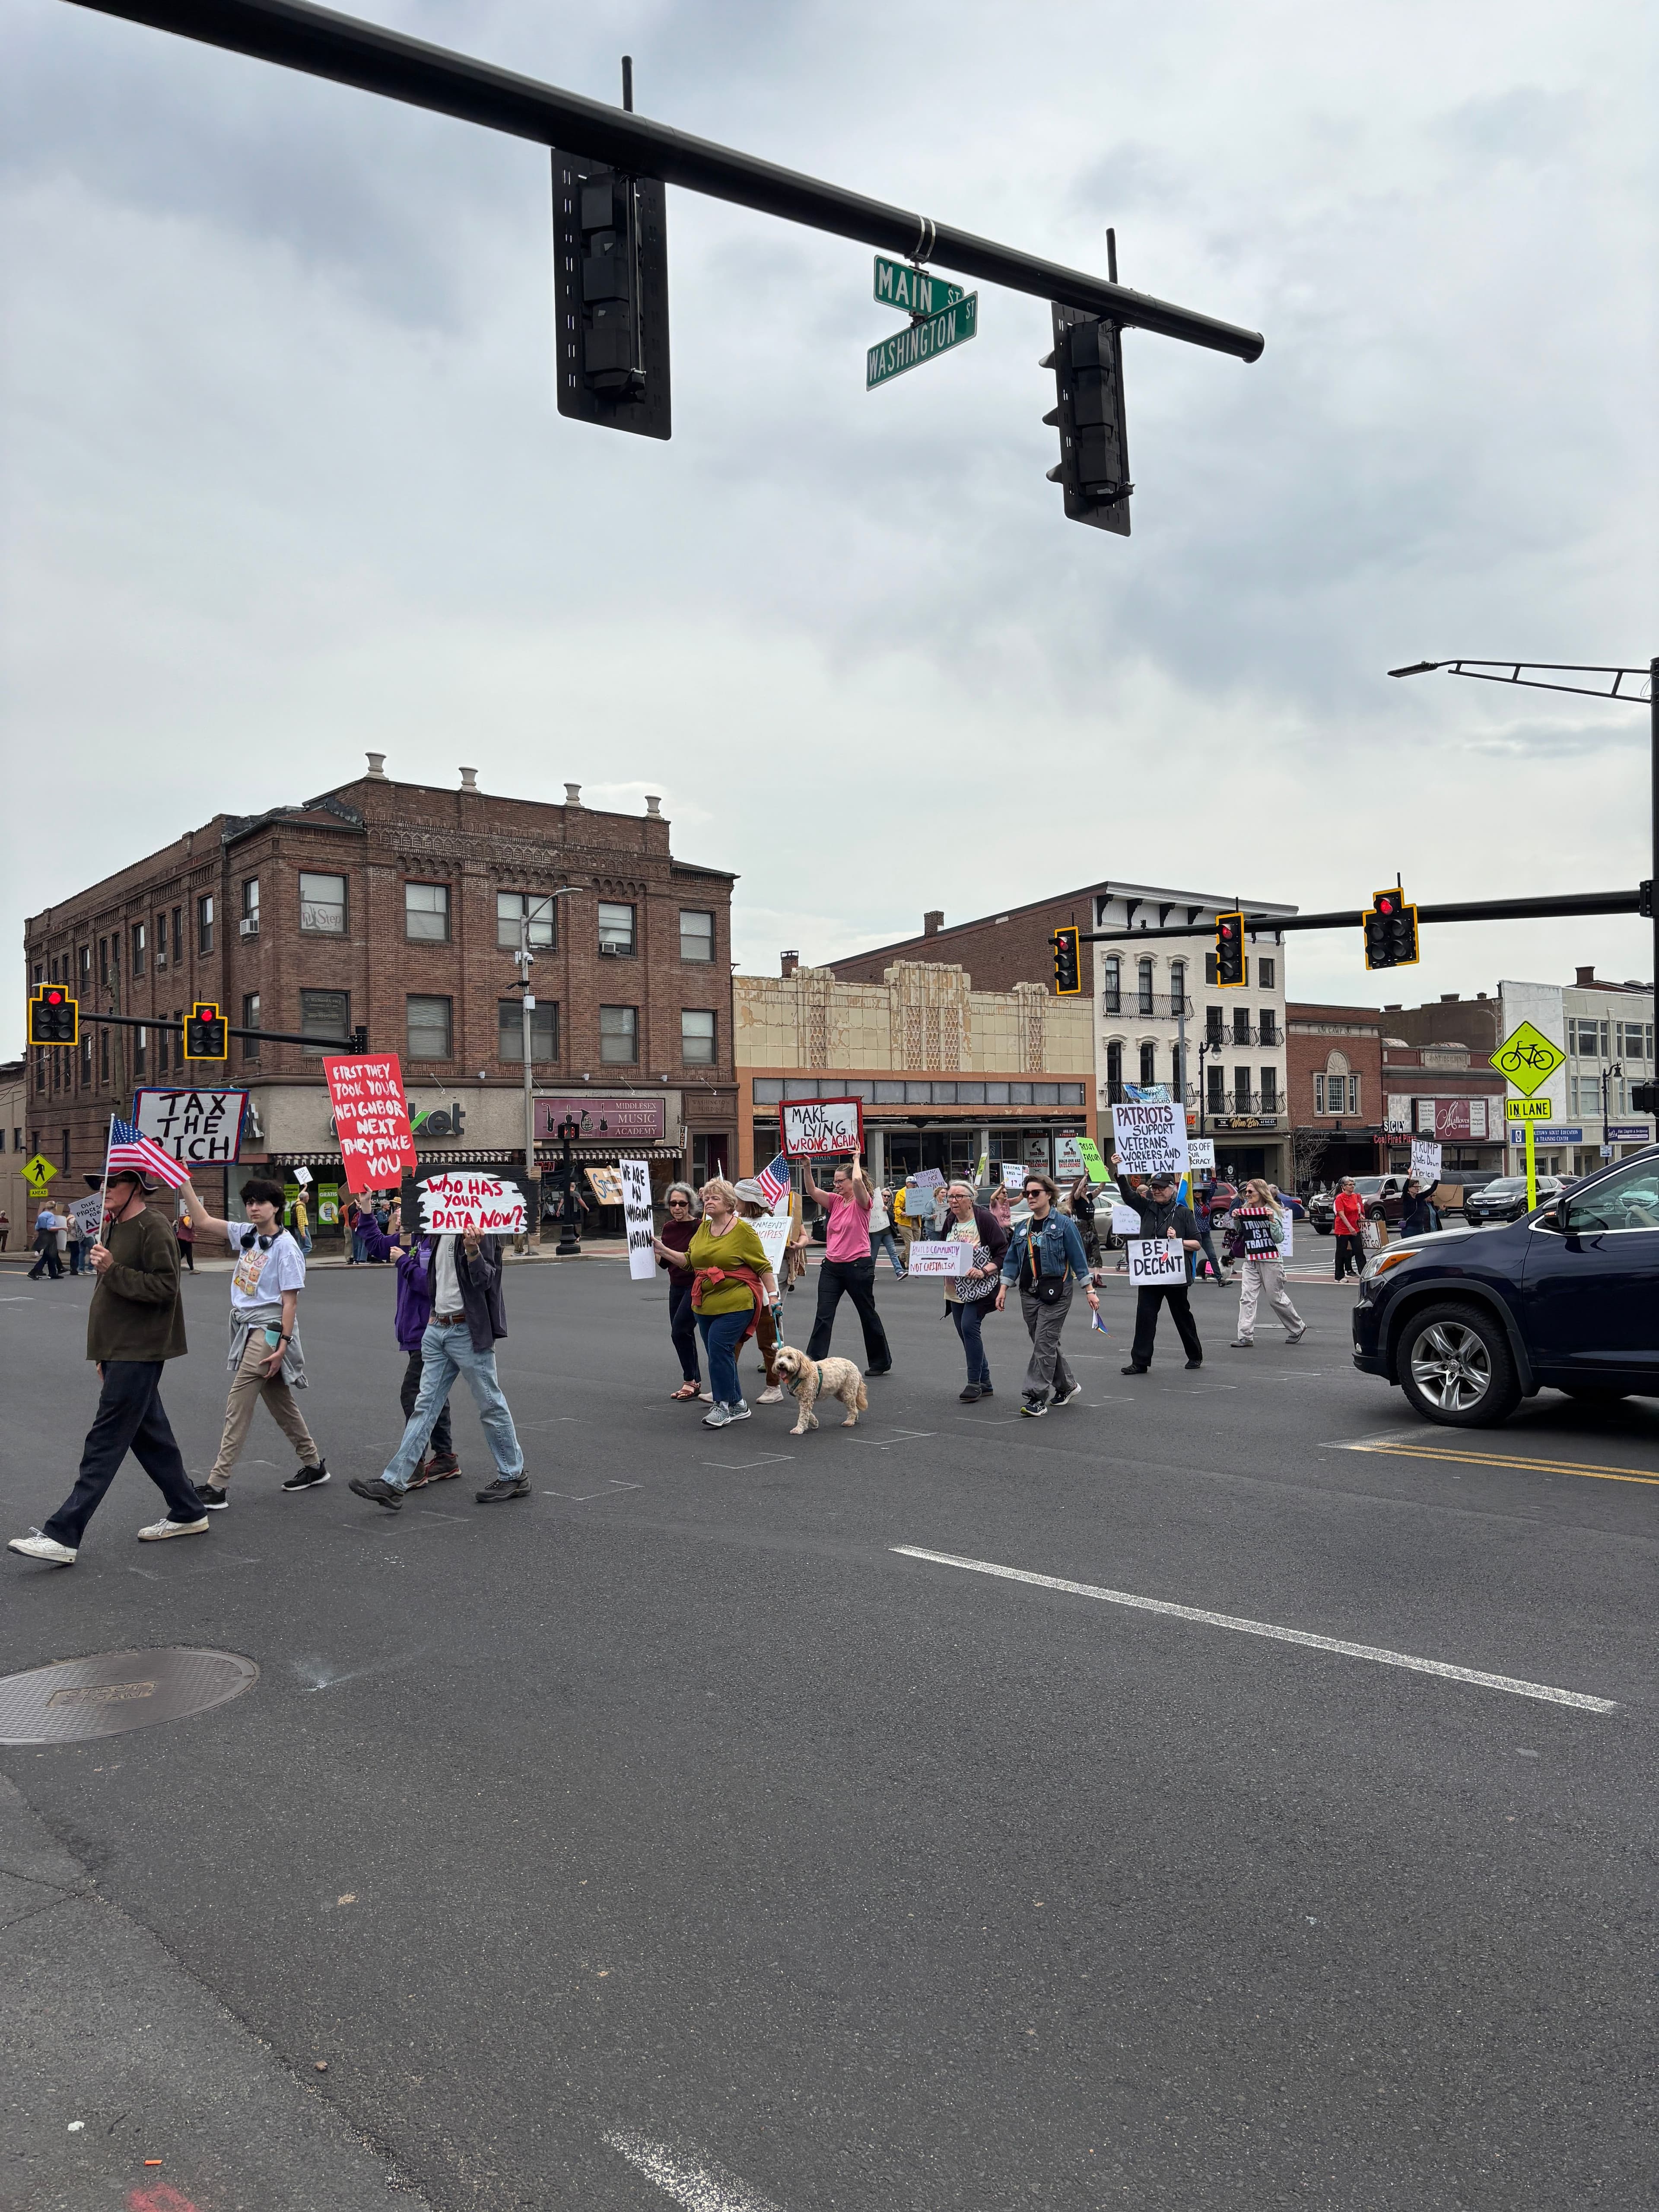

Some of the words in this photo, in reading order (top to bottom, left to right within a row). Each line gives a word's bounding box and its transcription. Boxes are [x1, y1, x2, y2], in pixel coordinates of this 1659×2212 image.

[878, 263, 932, 313] MAIN
[947, 289, 960, 305] ST
[868, 310, 956, 381] WASHINGTON
[966, 300, 975, 319] ST
[317, 909, 341, 927] Step
[333, 1065, 363, 1081] FIRST
[363, 1062, 390, 1081] THEY
[332, 1081, 364, 1100] TOOK
[366, 1080, 400, 1099] YOUR
[159, 1093, 226, 1116] TAX
[1510, 1103, 1519, 1116] IN
[1523, 1103, 1548, 1116] LANE
[618, 1114, 655, 1124] MUSIC
[792, 1104, 829, 1124] MAKE
[1116, 1105, 1173, 1126] PATRIOTS
[1229, 1116, 1246, 1128] Wine
[1246, 1117, 1259, 1128] Bar
[1436, 1101, 1469, 1137] Malloves
[157, 1115, 222, 1138] THE
[357, 1118, 397, 1136] NEXT
[804, 1121, 846, 1138] LYING
[1132, 1123, 1175, 1136] SUPPORT
[1383, 1120, 1405, 1132] SICILY
[341, 1138, 374, 1156] THEY
[375, 1135, 411, 1152] TAKE
[788, 1137, 828, 1151] WRONG
[831, 1133, 859, 1149] AGAIN
[1118, 1136, 1169, 1151] VETERANS,
[1199, 1142, 1211, 1151] OFF
[1373, 1134, 1387, 1144] Coal
[1387, 1134, 1402, 1144] Fired
[1413, 1139, 1438, 1155] TRUMP
[1163, 1147, 1181, 1159] AND
[367, 1154, 401, 1177] YOU
[1125, 1160, 1148, 1173] THE
[1153, 1160, 1175, 1172] LAW
[622, 1163, 631, 1182] WE
[632, 1165, 645, 1186] ARE
[468, 1179, 503, 1197] HAS
[632, 1183, 642, 1204] AN
[81, 1200, 95, 1208] DUE
[443, 1194, 483, 1209] YOUR
[432, 1210, 475, 1229] DATA
[479, 1205, 523, 1233] NOW?
[1243, 1220, 1270, 1230] TRUMP
[629, 1228, 652, 1253] NATION
[1252, 1229, 1262, 1239] IS
[1262, 1229, 1269, 1238] A
[912, 1245, 930, 1254] BUILD
[930, 1245, 960, 1256] COMMUNITY
[1141, 1240, 1164, 1257] BE
[1244, 1238, 1275, 1249] TRAITO
[1371, 1239, 1379, 1248] GO
[910, 1262, 923, 1272] NOT
[924, 1261, 956, 1272] CAPITALISM
[1133, 1255, 1182, 1276] DECENT
